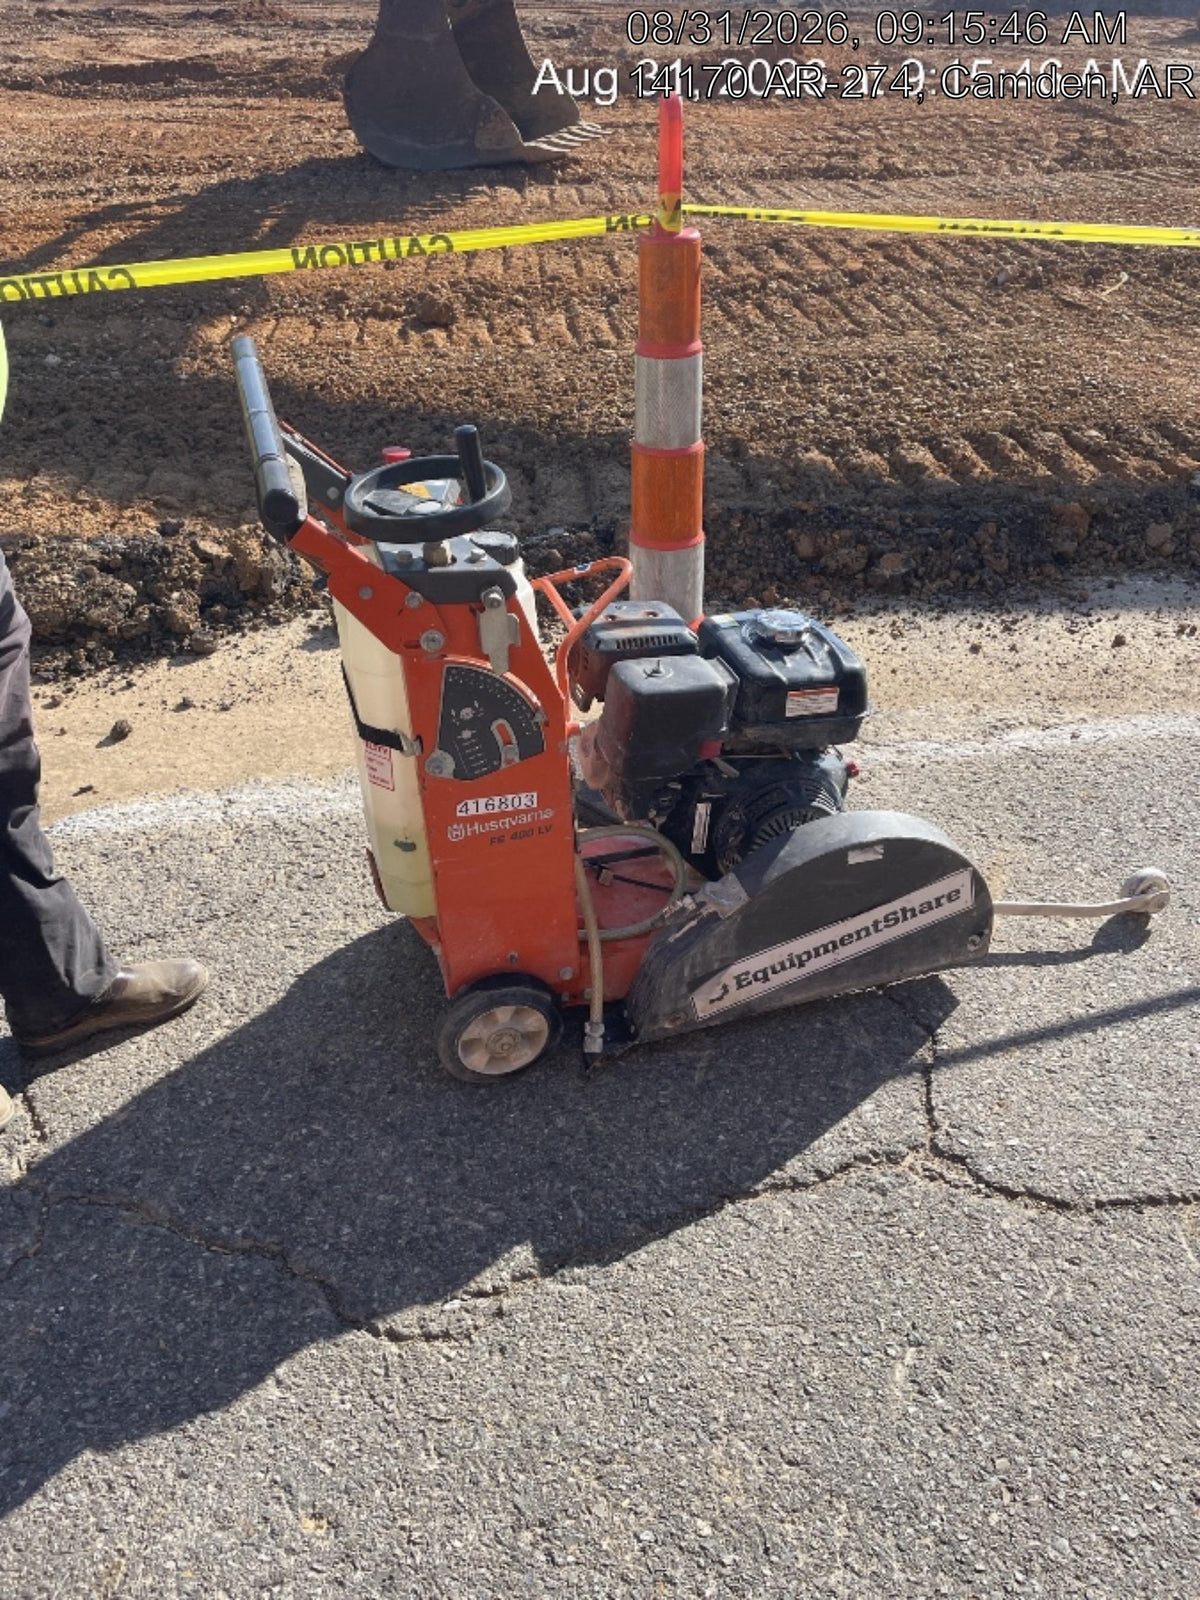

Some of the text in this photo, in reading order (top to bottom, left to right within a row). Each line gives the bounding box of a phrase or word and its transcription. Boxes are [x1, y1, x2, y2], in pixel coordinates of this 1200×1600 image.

[458, 794, 535, 815] 416803
[466, 809, 555, 836] Husqvarna
[732, 887, 962, 991] EquipmentShare
